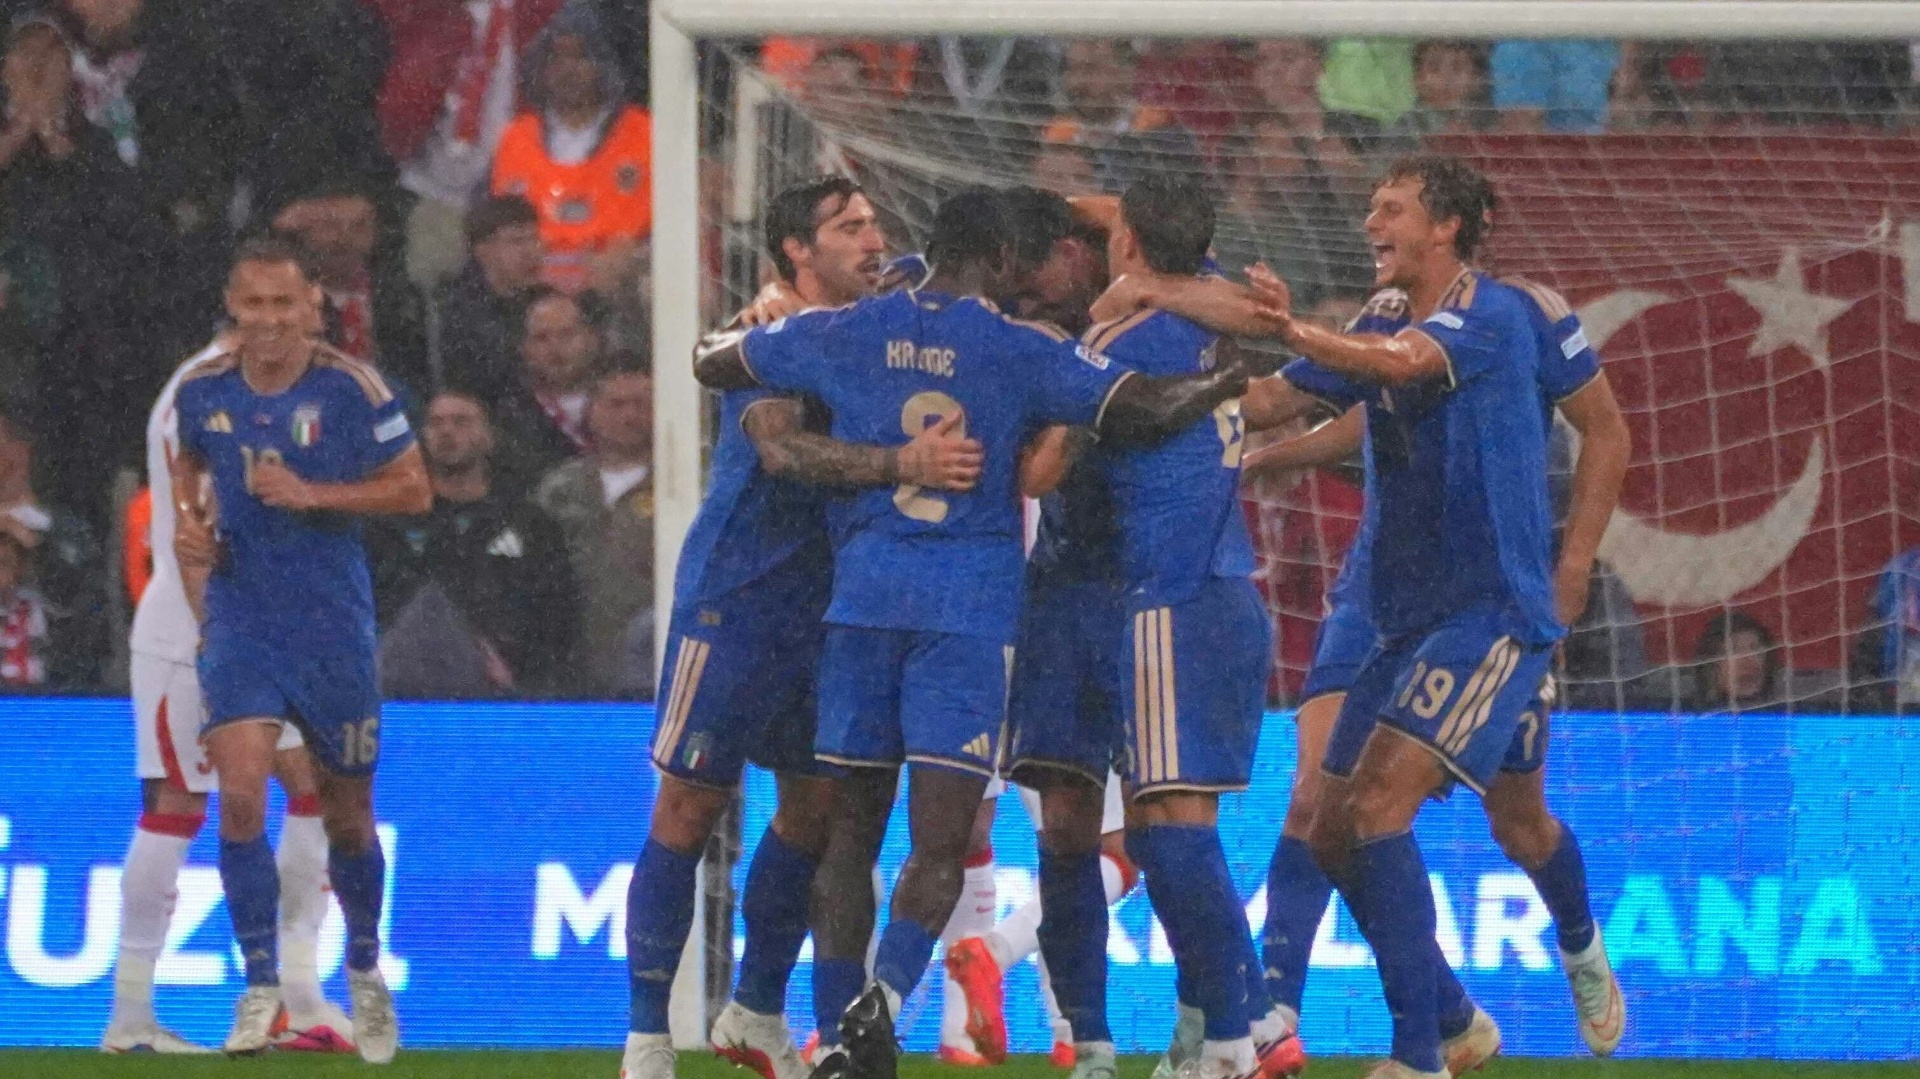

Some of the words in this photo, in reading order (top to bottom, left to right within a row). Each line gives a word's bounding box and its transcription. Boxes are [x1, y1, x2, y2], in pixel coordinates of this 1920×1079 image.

[1397, 660, 1455, 719] 19
[342, 716, 379, 767] 16
[1601, 873, 1883, 976] ANA
